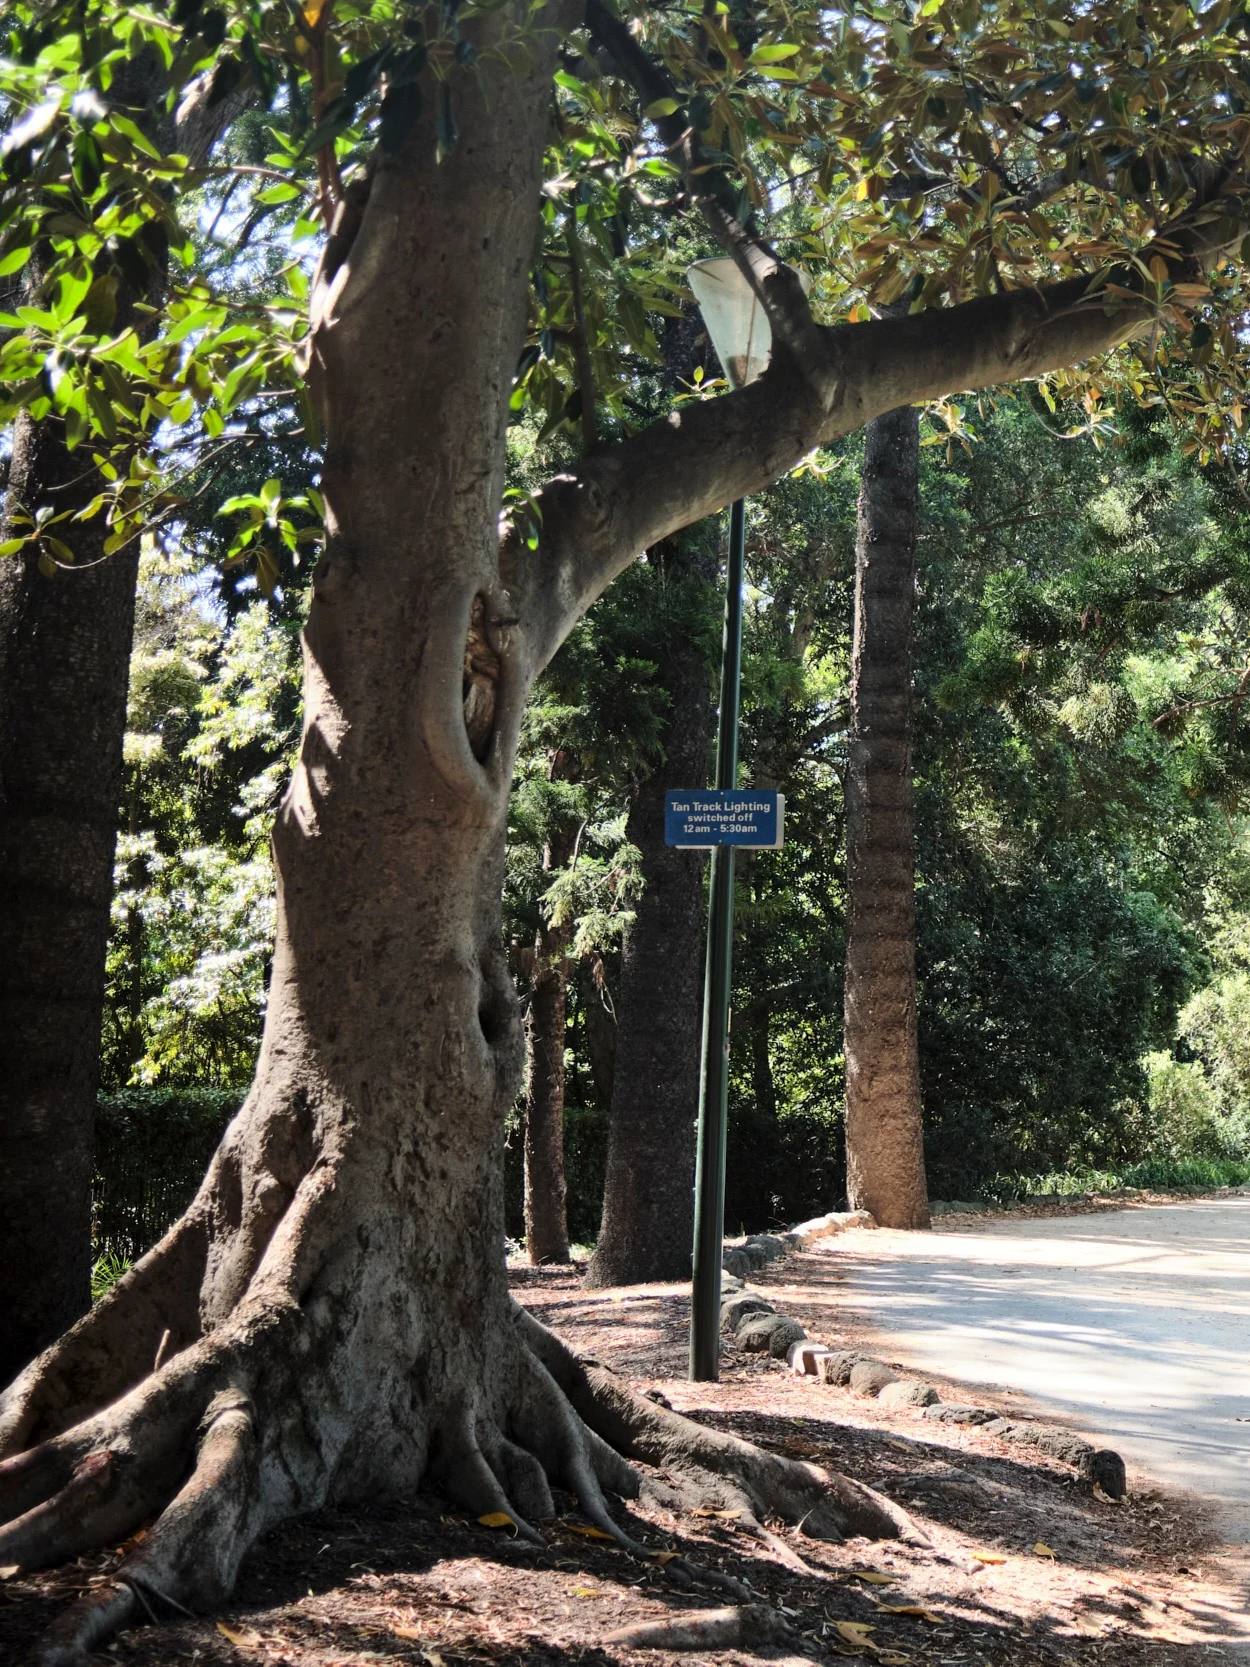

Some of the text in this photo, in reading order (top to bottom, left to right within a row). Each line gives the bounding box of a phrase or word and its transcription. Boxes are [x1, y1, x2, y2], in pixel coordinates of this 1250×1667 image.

[671, 801, 771, 813] Tan Track Lighting
[687, 813, 753, 822] switched off
[720, 824, 757, 833] 5:30am
